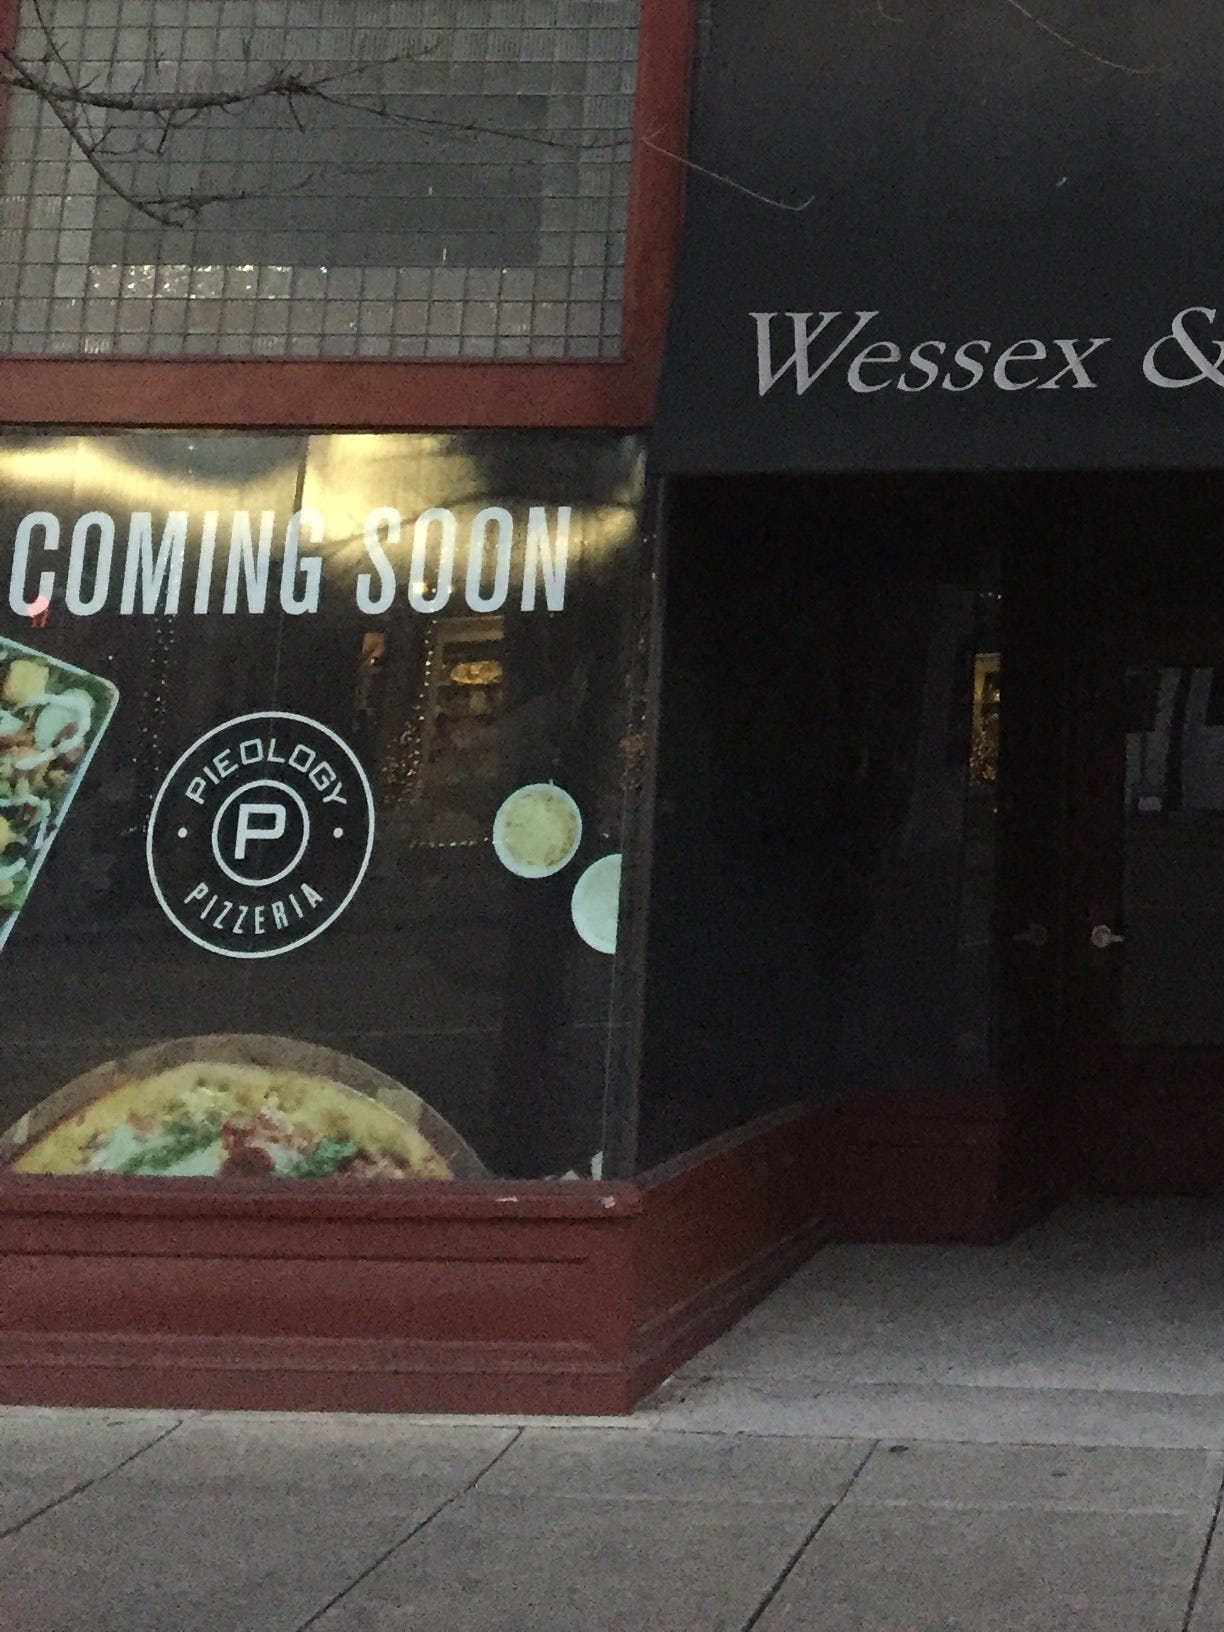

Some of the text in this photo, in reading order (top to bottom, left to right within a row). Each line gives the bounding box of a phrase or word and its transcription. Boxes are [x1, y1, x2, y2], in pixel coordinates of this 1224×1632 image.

[748, 310, 1112, 397] Wessex
[8, 505, 573, 617] COMING SOON
[185, 736, 348, 806] PIEOLOGY
[234, 803, 287, 860] P
[183, 881, 324, 935] PIZZERIA
